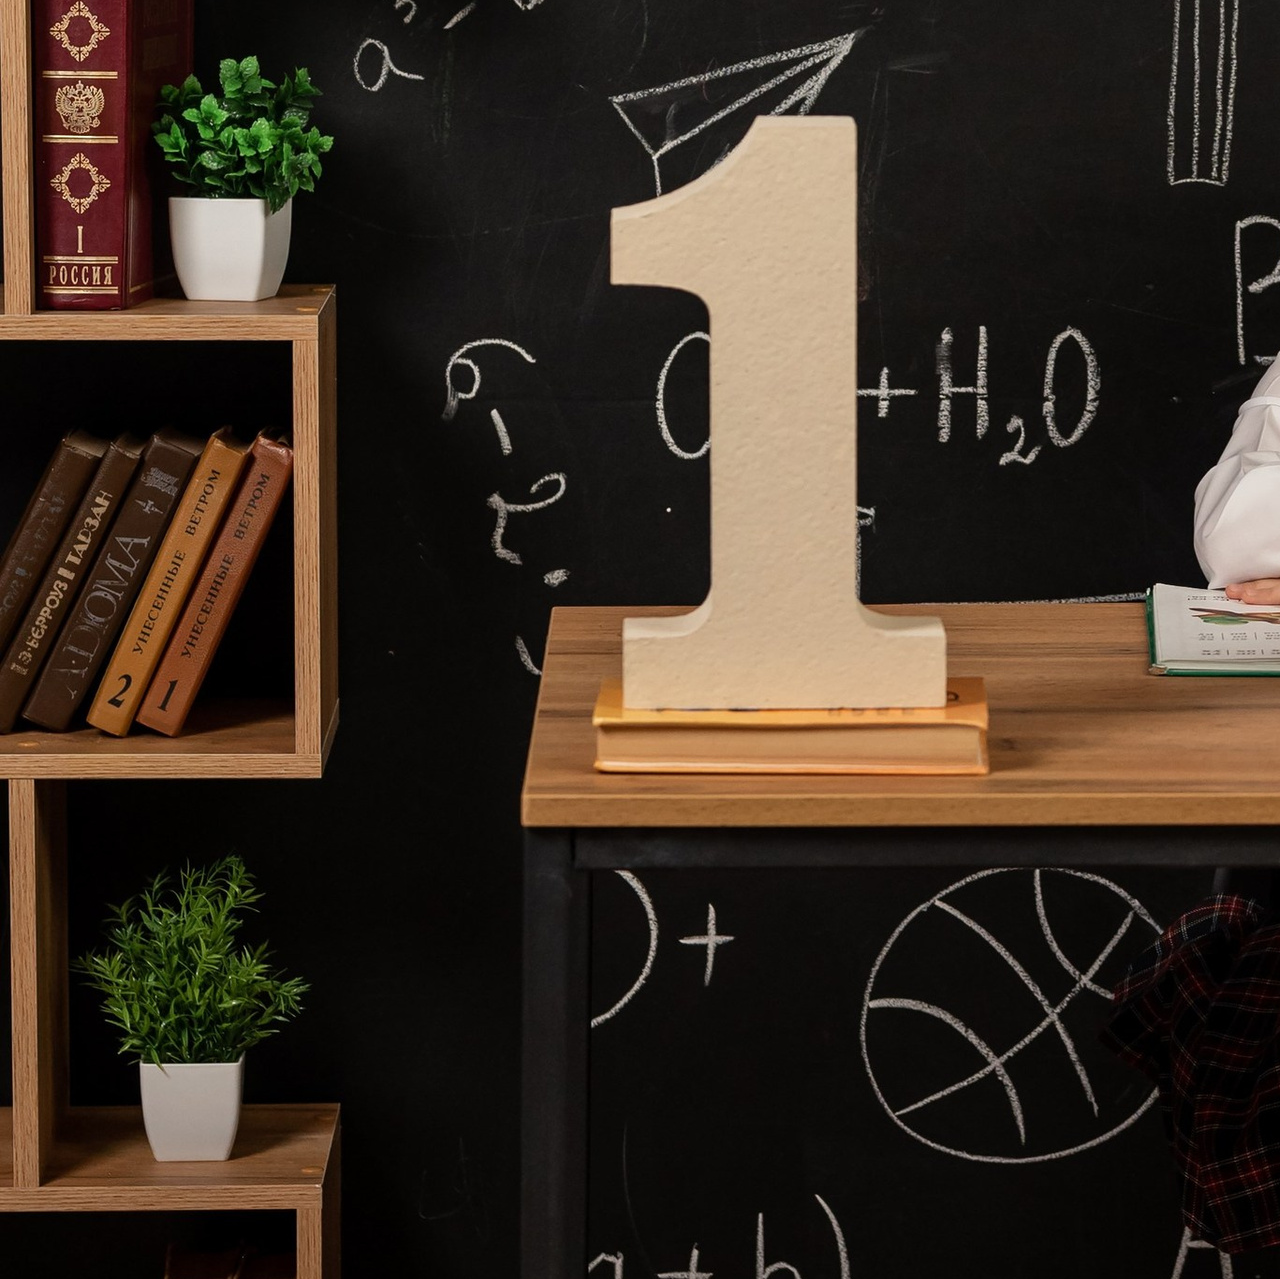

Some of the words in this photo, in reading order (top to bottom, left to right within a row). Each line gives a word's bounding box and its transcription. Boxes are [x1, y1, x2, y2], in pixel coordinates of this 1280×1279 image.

[49, 264, 113, 285] РОССИЯ
[65, 490, 114, 566] ТАРЗАН
[132, 550, 187, 655] УНЕСЕННЫЕ
[185, 469, 221, 537] ВЕТРОМ
[180, 553, 235, 659] УНЕСЕННЫЕ
[233, 473, 270, 542] ВЕТРОМ
[107, 673, 133, 709] 2
[157, 678, 179, 712] 1
